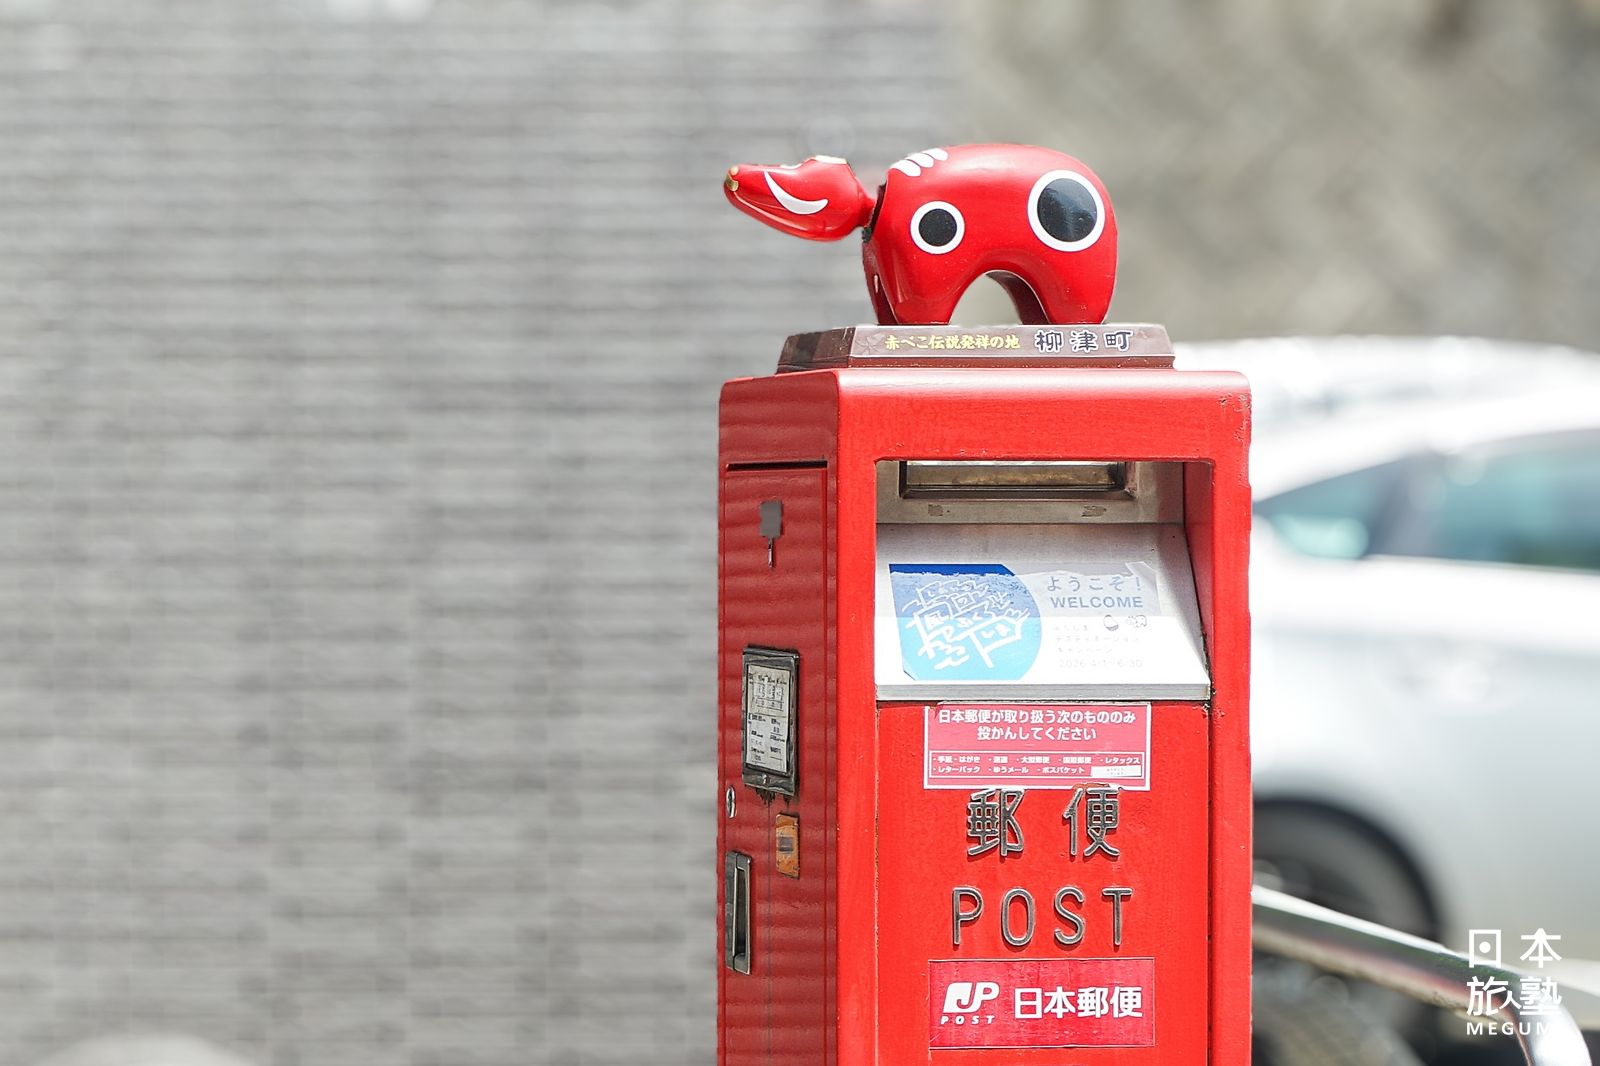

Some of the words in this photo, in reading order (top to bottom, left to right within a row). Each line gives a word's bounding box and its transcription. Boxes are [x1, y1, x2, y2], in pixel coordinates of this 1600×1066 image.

[885, 334, 1020, 350] 赤べこ伝説発祥の地
[1034, 330, 1133, 353] 柳津町
[1049, 596, 1144, 609] WELCOME
[938, 709, 1137, 724] 日本郵便が取り扱う次のもののみ
[977, 726, 1097, 741] 投かんしてください
[967, 786, 1121, 857] 郵便
[952, 885, 1133, 947] POST
[1014, 986, 1143, 1019] 日本郵便
[940, 1015, 995, 1025] POST
